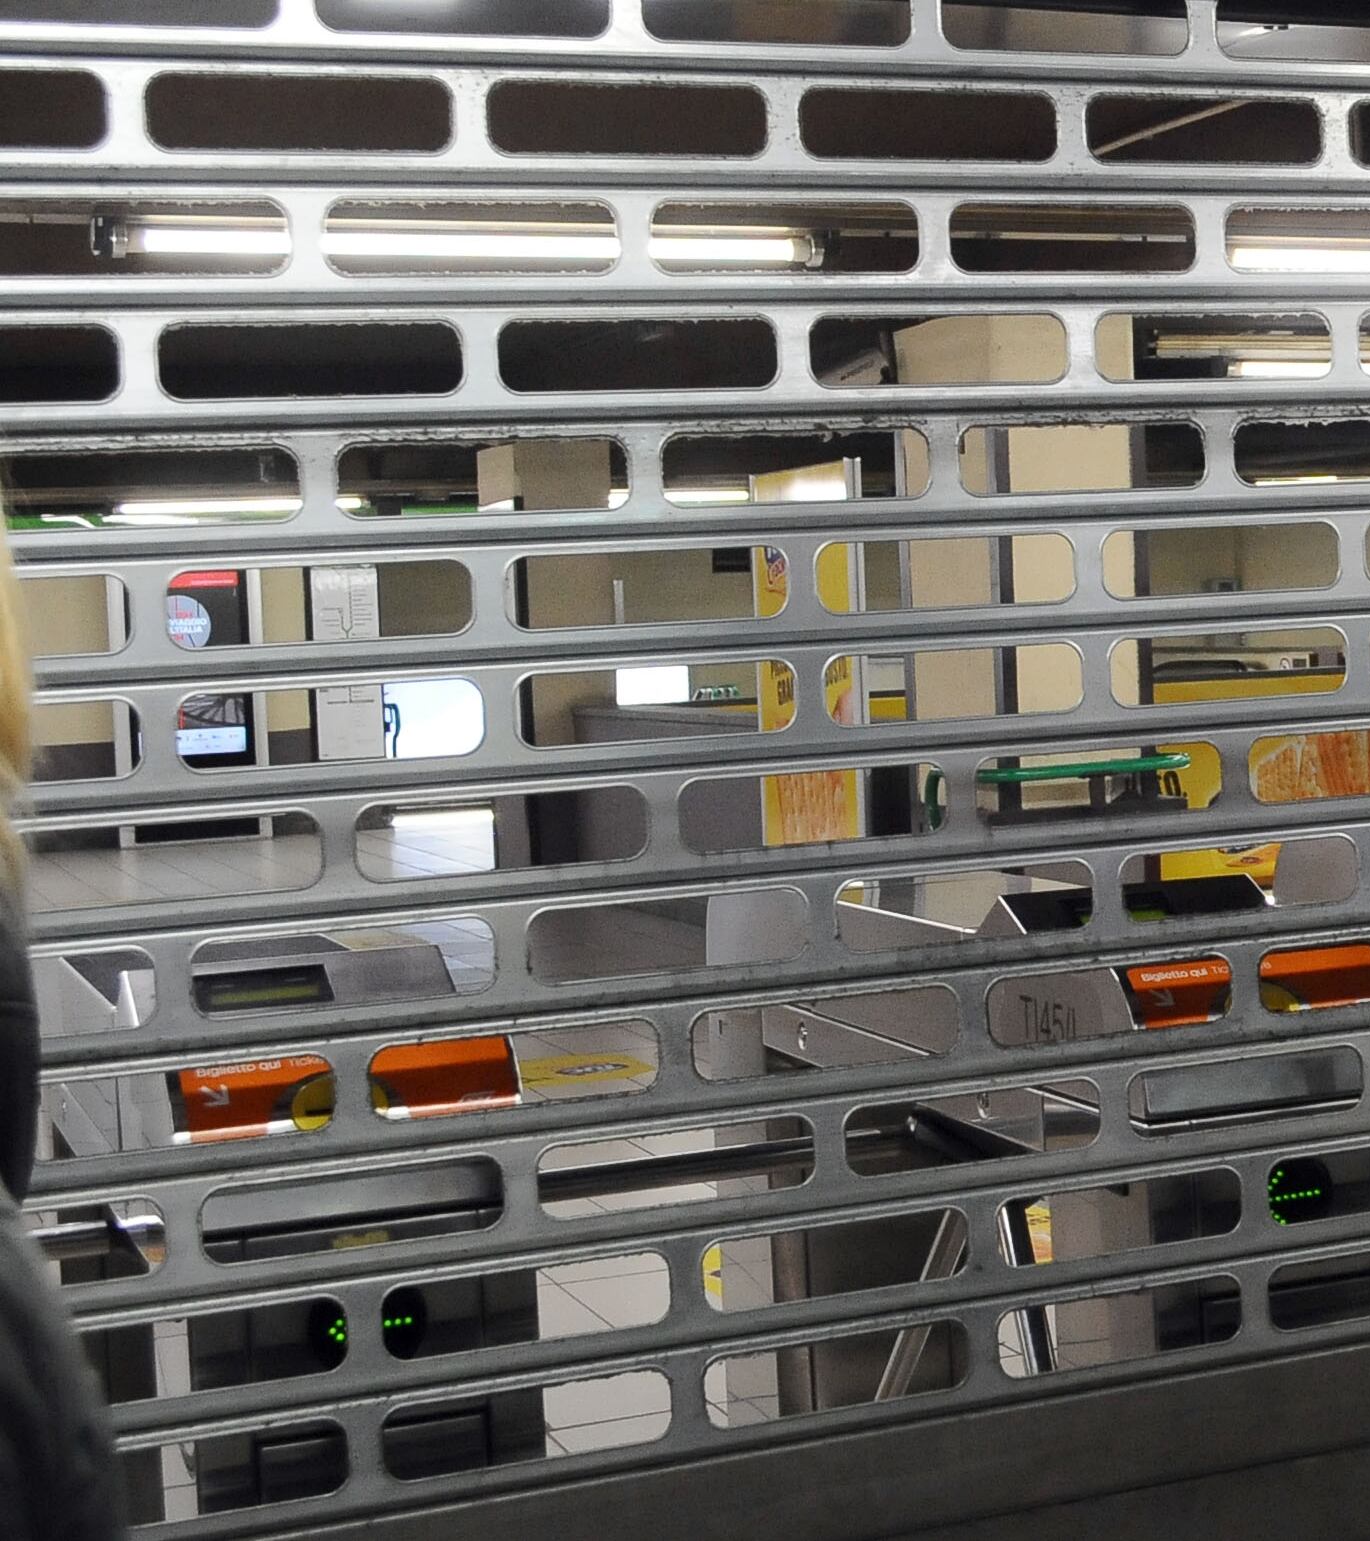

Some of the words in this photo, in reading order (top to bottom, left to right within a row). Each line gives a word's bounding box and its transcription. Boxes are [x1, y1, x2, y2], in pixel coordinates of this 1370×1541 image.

[1141, 971, 1187, 982] Biglietto
[1190, 968, 1208, 978] qui
[196, 1063, 256, 1078] Biglietto
[259, 1060, 282, 1071] qui
